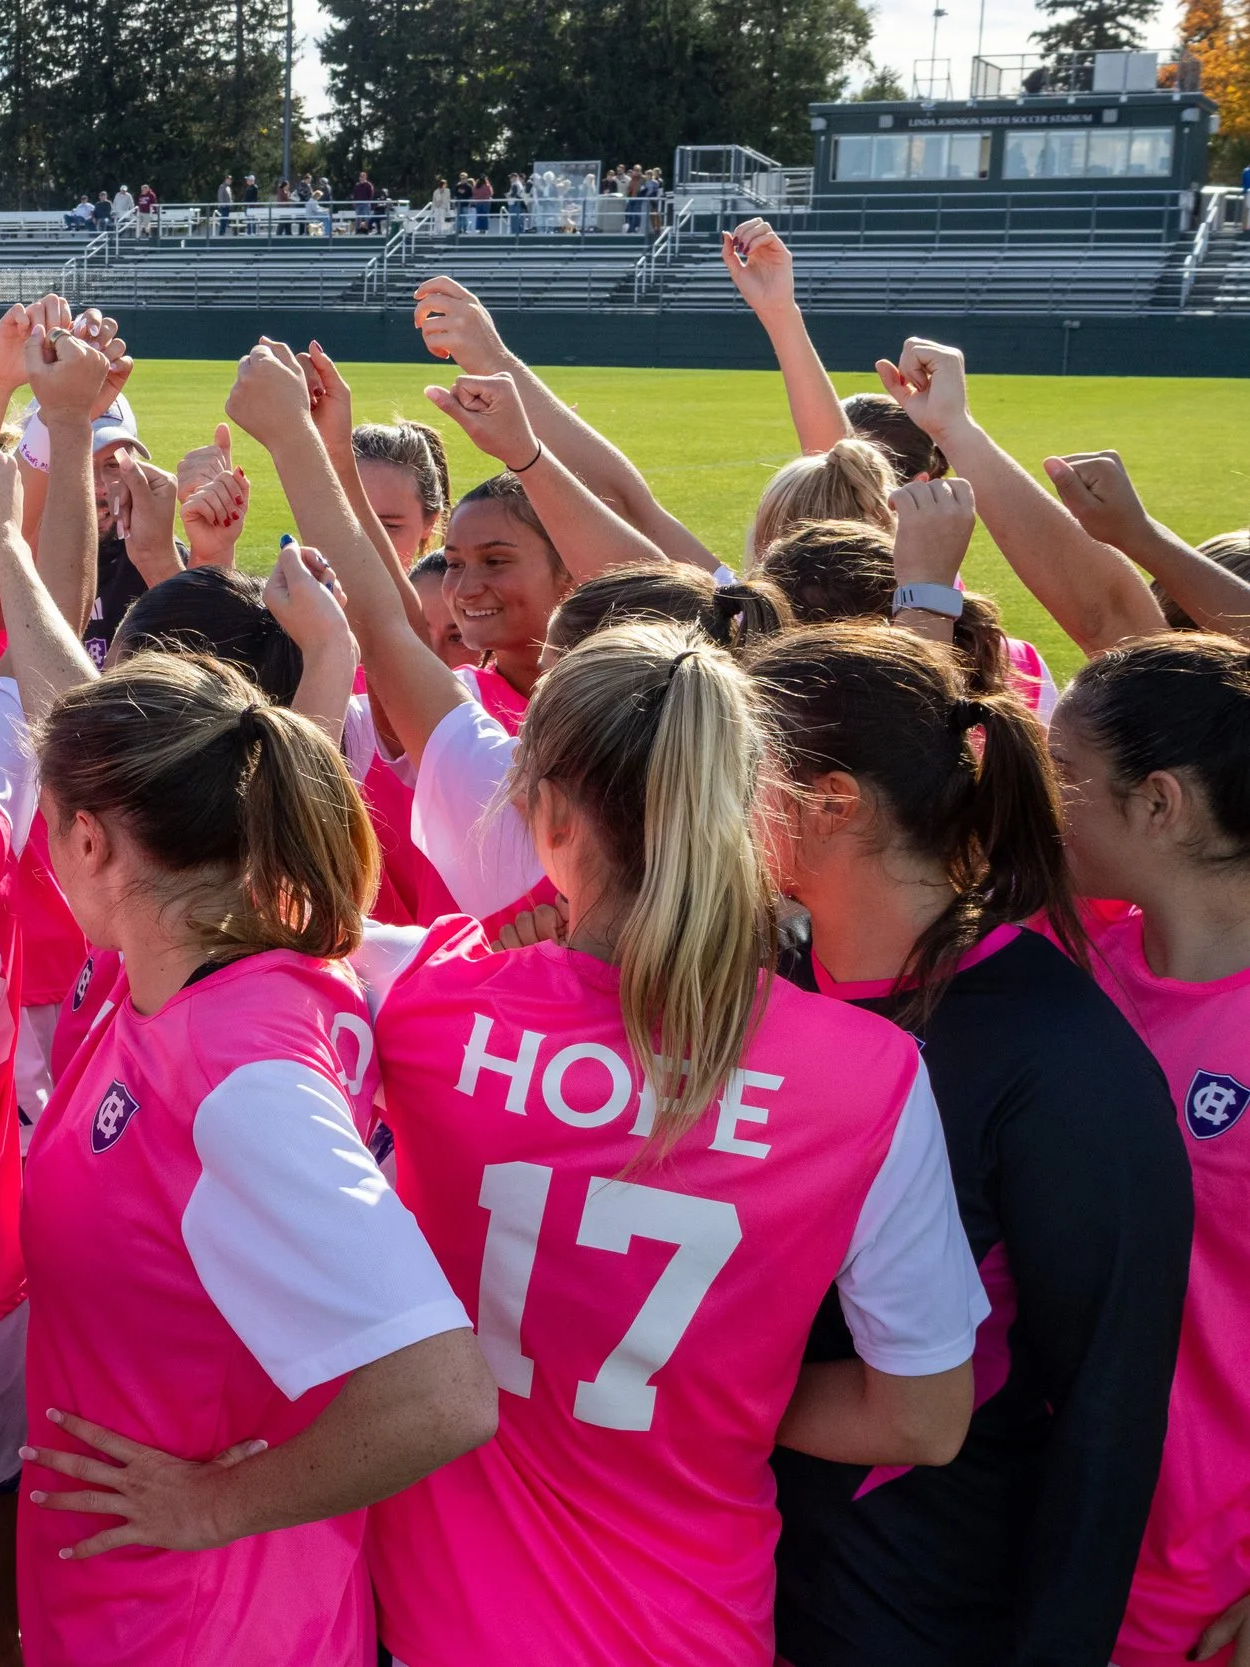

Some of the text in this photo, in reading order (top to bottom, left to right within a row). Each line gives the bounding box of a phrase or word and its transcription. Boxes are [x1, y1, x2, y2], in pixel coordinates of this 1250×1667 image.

[908, 113, 1093, 127] LINDA JOHNSON SMITH SOCCER STADIUM
[477, 1160, 743, 1432] 17
